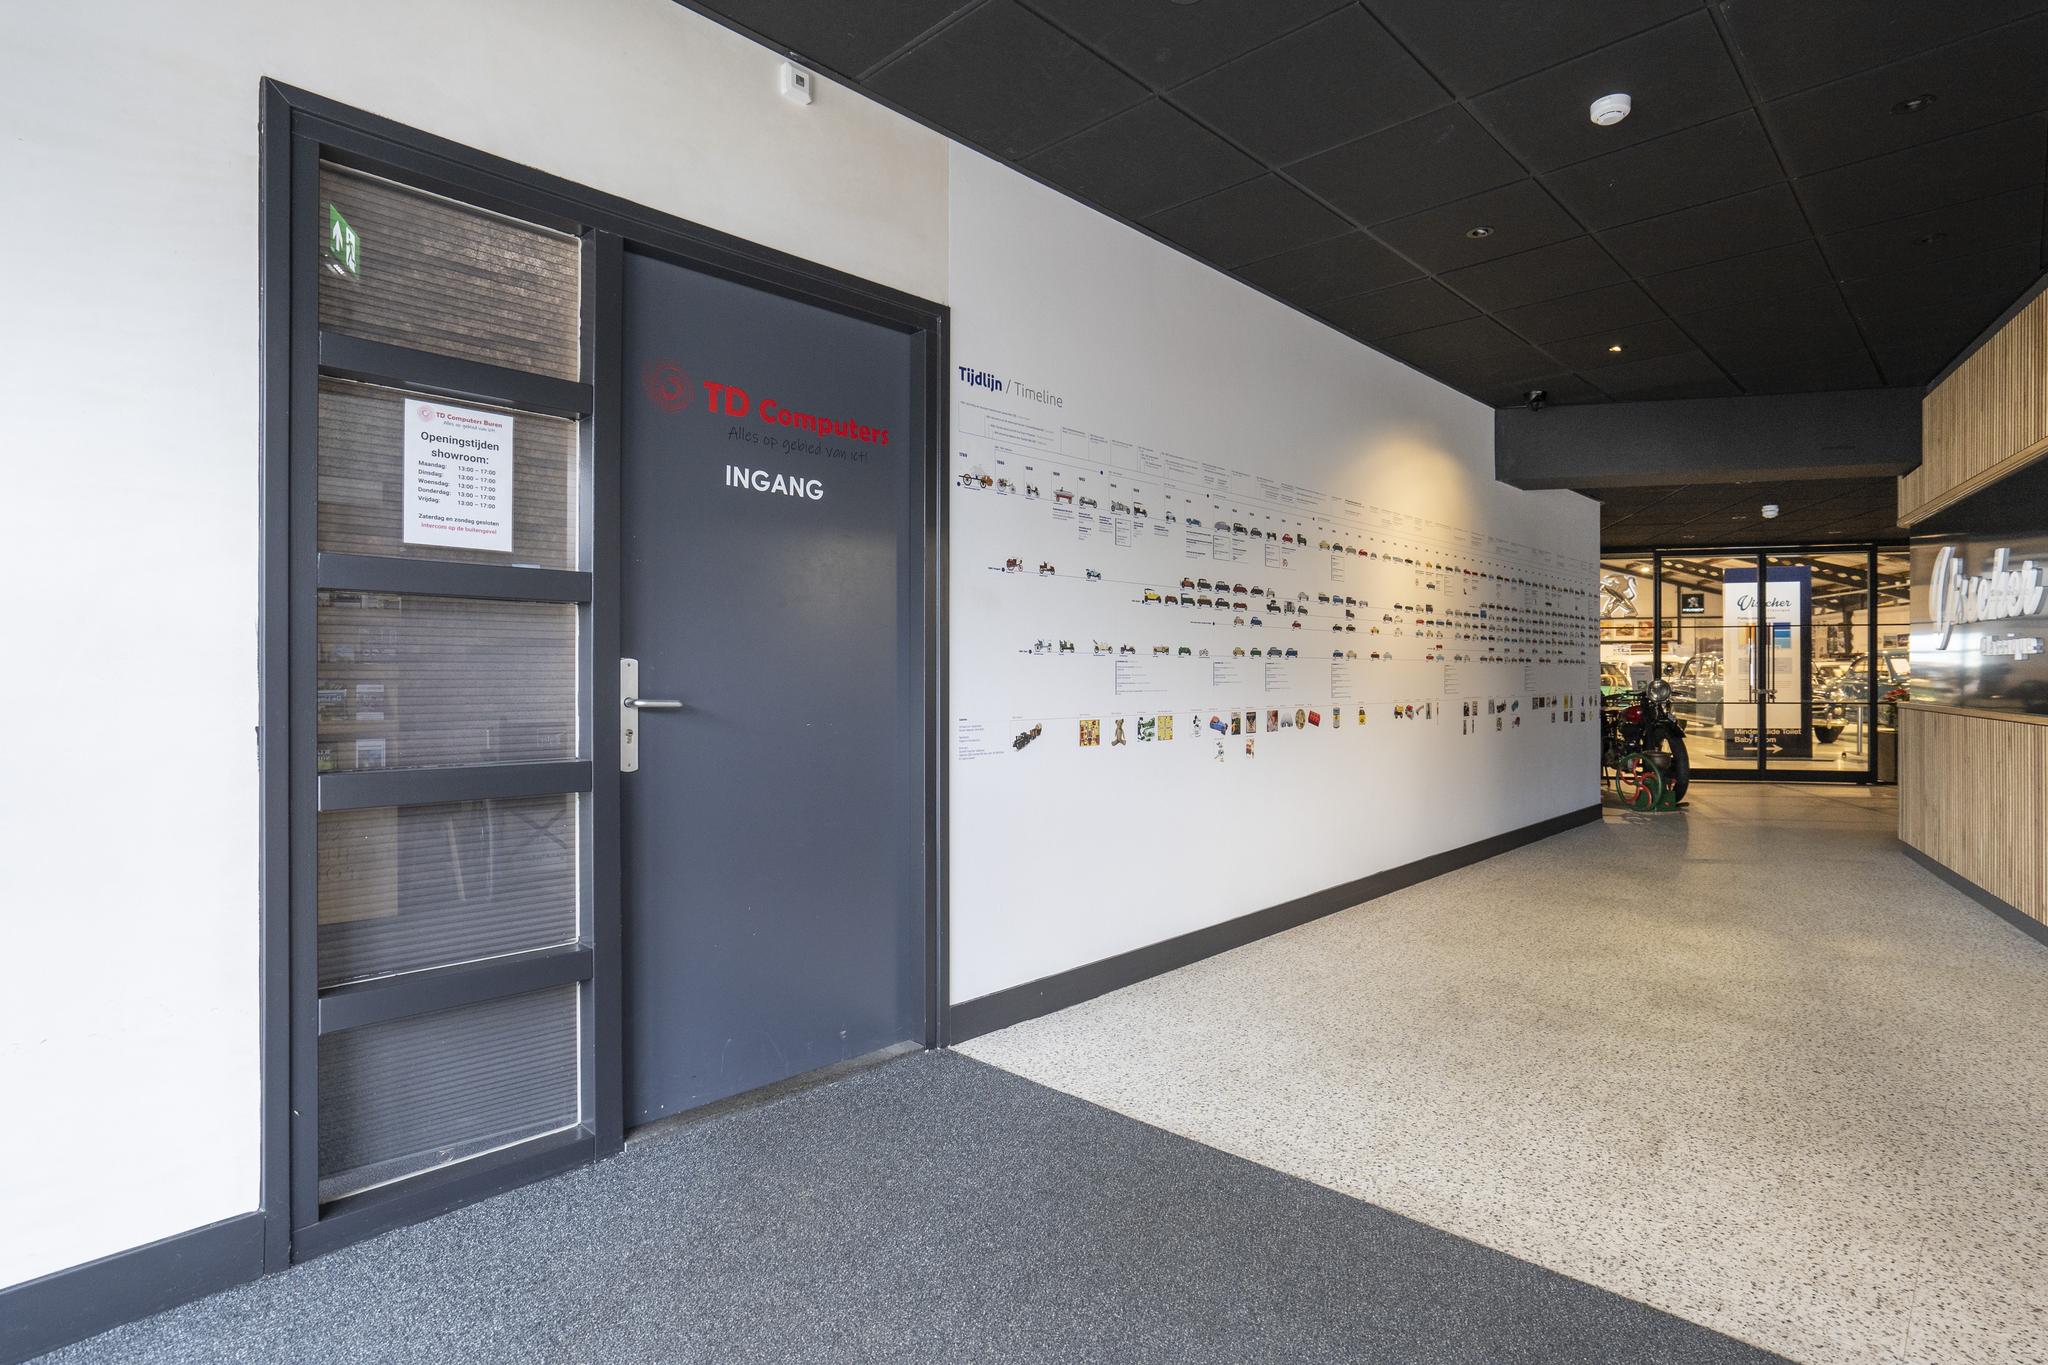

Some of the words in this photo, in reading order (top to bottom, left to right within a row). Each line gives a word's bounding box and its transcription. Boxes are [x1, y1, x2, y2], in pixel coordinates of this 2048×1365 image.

[959, 366, 1002, 392] Tijdlijn
[1014, 381, 1063, 408] Timeline
[436, 411, 445, 419] TD
[447, 413, 482, 426] Computers
[483, 420, 503, 429] Buren
[703, 380, 750, 418] TD
[759, 399, 889, 446] Computers
[420, 431, 500, 452] Openingstijden
[728, 426, 759, 444] Alles
[763, 434, 778, 448] op
[782, 438, 822, 456] gebied
[825, 447, 846, 461] van
[418, 460, 447, 470] Maandag:
[431, 448, 489, 465] showroom:
[725, 464, 824, 501] INGANG
[417, 495, 440, 504] Vrijdag:
[418, 513, 445, 522] Zaterdag
[454, 517, 475, 525] zondag
[475, 519, 500, 527] gesloten
[1734, 736, 1754, 744] Baby
